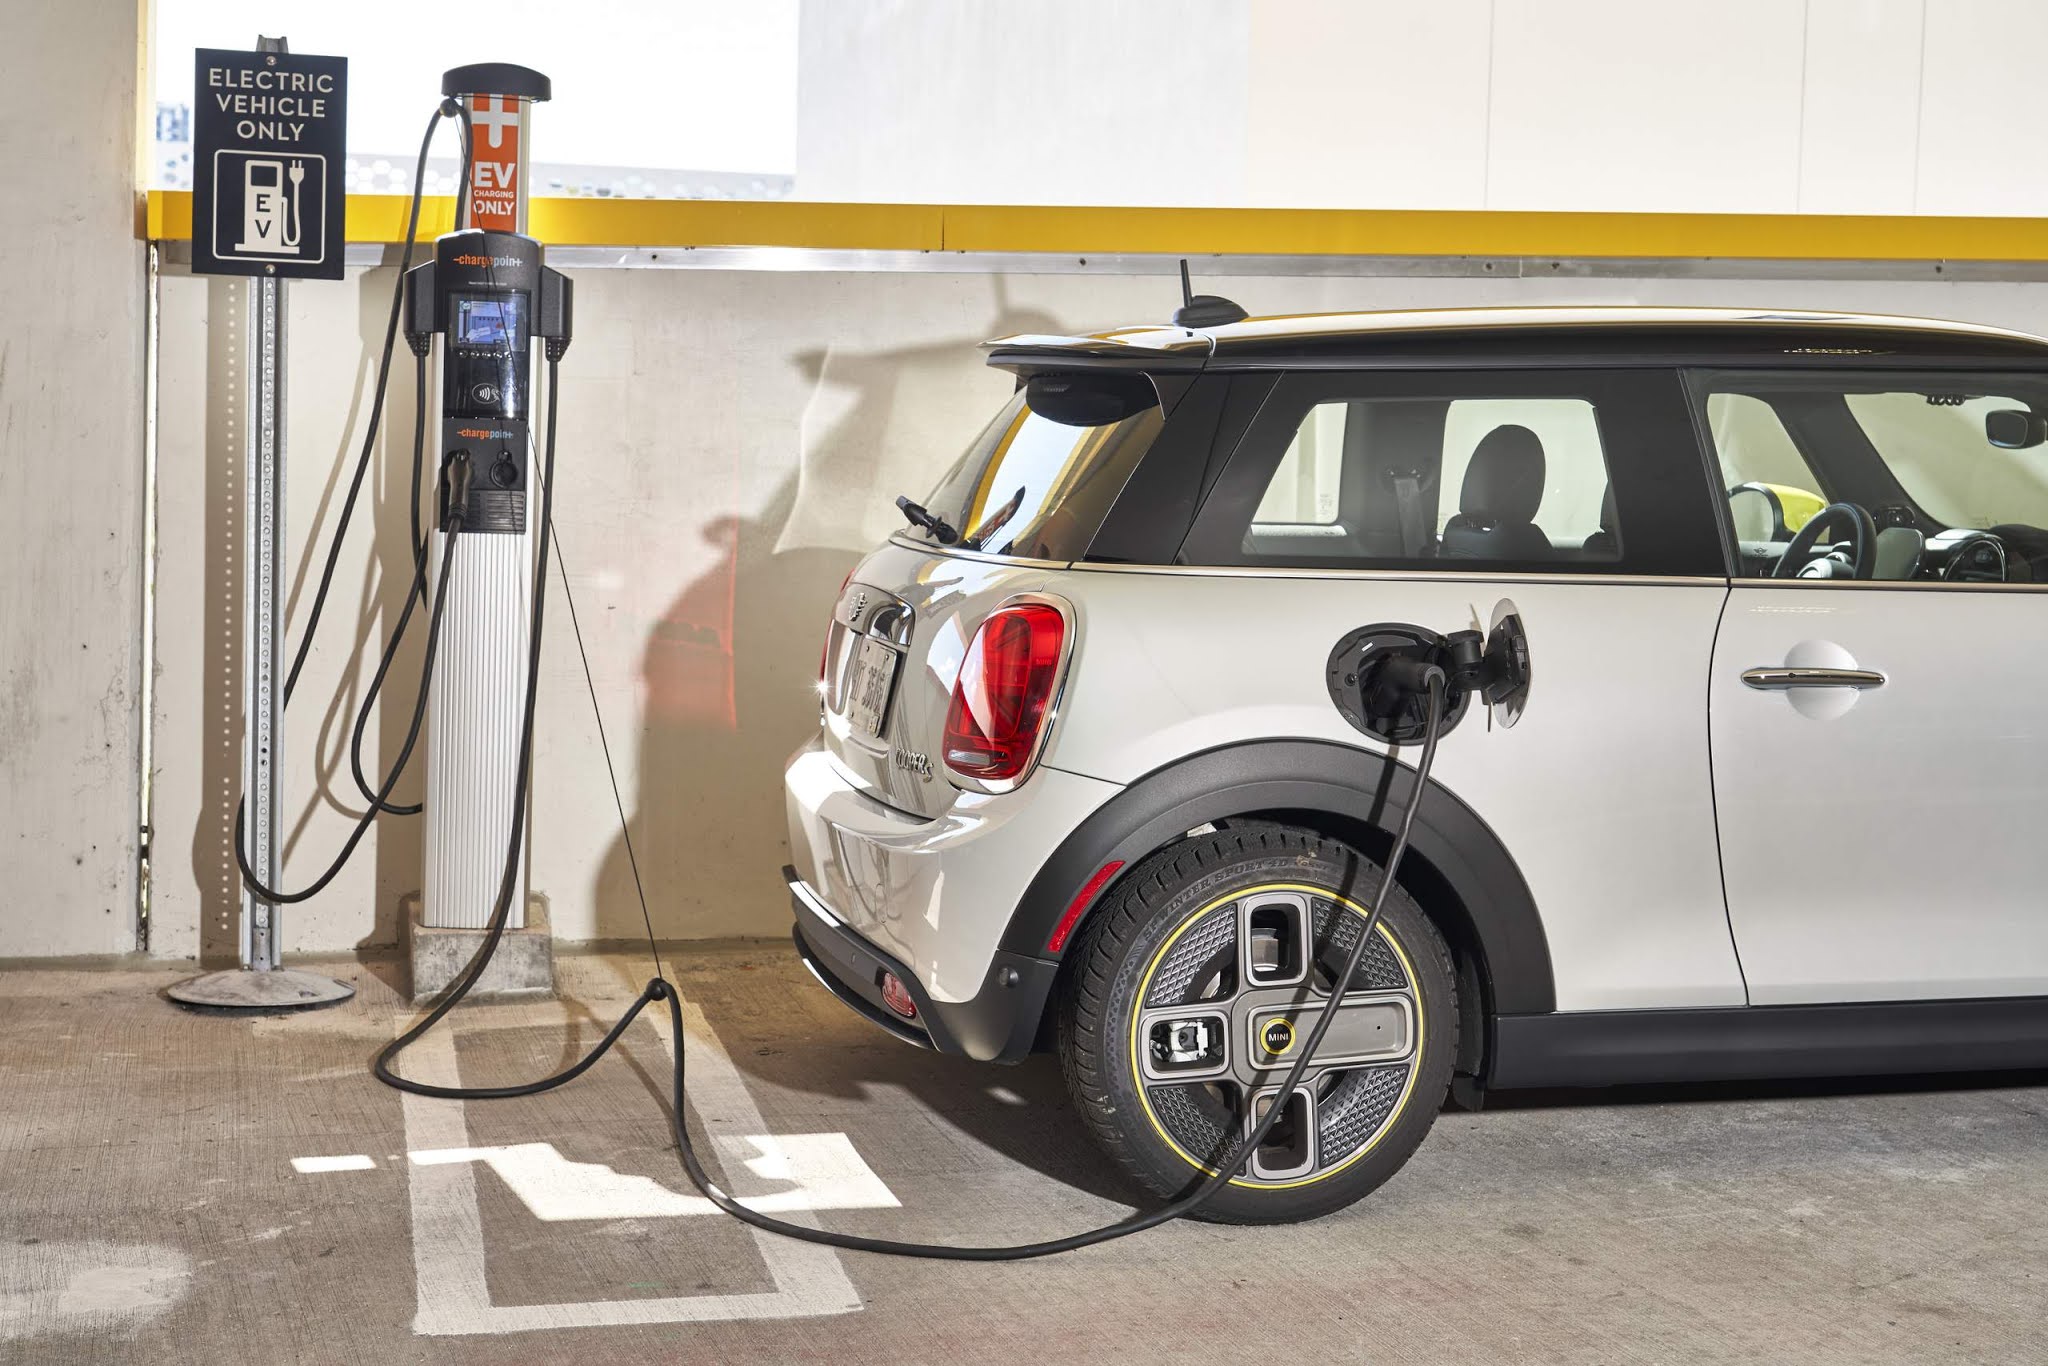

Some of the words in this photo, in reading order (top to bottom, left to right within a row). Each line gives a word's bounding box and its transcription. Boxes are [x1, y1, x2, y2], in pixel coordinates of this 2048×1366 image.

[209, 67, 333, 93] ELECTRIC
[216, 93, 326, 118] VEHICLE
[236, 120, 304, 141] ONLY
[474, 161, 516, 188] EV
[473, 189, 514, 198] CHARGING
[473, 200, 515, 216] ONLY
[1159, 877, 1212, 920] WINTER
[1213, 860, 1265, 882] SPORT
[1268, 1033, 1289, 1042] MINI
